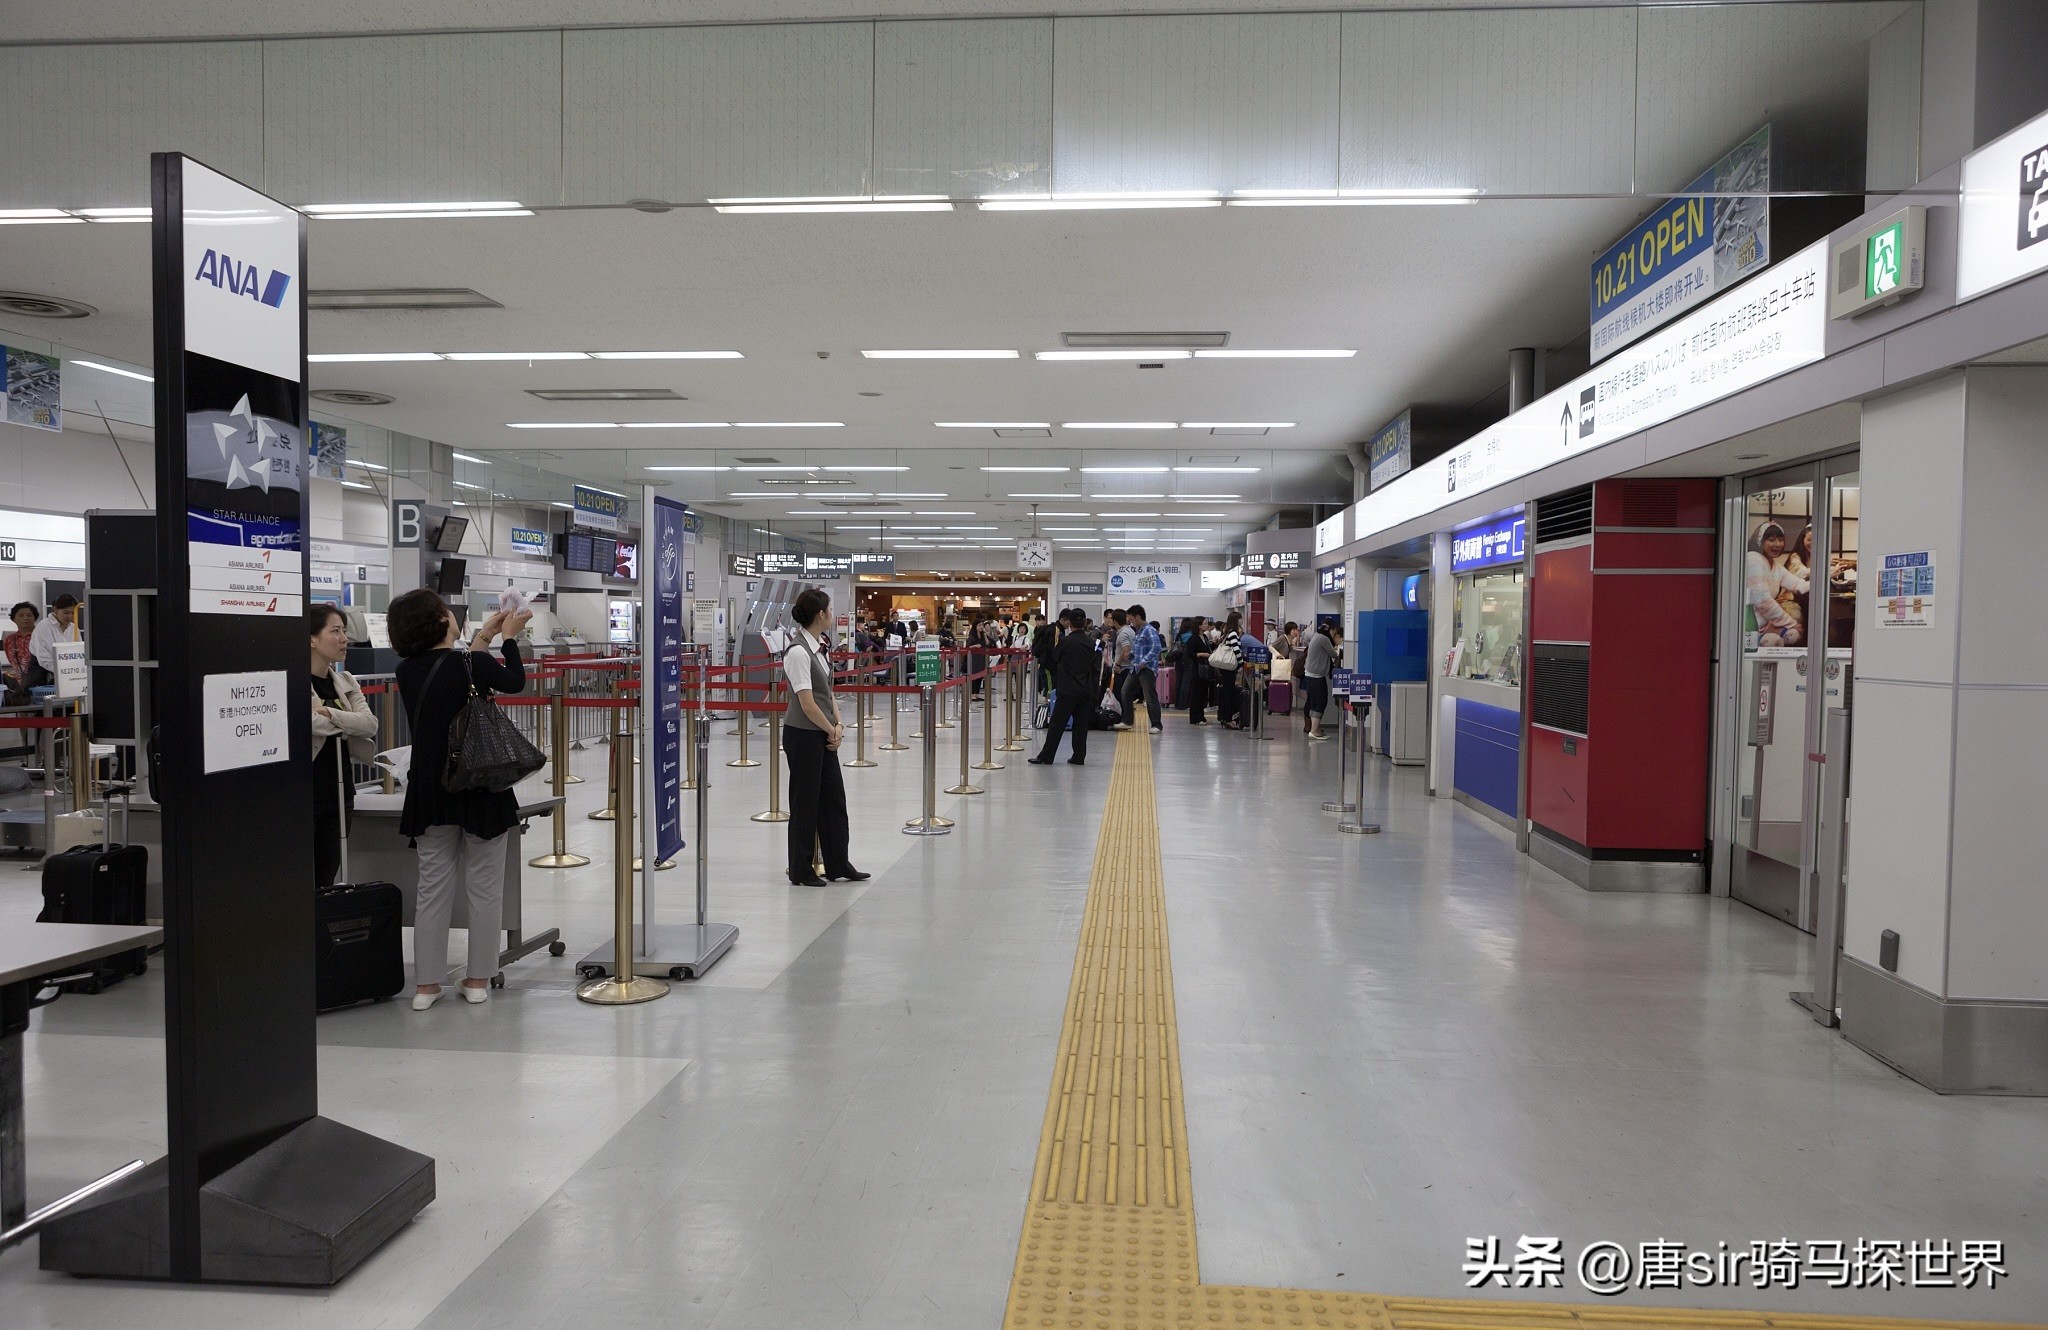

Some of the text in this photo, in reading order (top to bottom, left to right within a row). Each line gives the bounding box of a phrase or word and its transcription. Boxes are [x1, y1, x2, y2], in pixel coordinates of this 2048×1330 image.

[1594, 191, 1705, 308] 10.21 OPEN
[195, 248, 260, 302] ANA
[577, 491, 616, 513] 10.21 OPEN
[213, 508, 280, 526] STAR ALLIANCE
[398, 504, 421, 543] B
[513, 531, 542, 544] 10.21 OPEN
[1, 545, 15, 559] 10
[228, 560, 245, 568] ASIANA
[220, 599, 244, 607] SHANGHAI
[231, 685, 266, 699] NH1275
[219, 703, 277, 719] 香港/HONGKONG
[235, 723, 262, 737] OPEN
[262, 748, 273, 757] ANA
